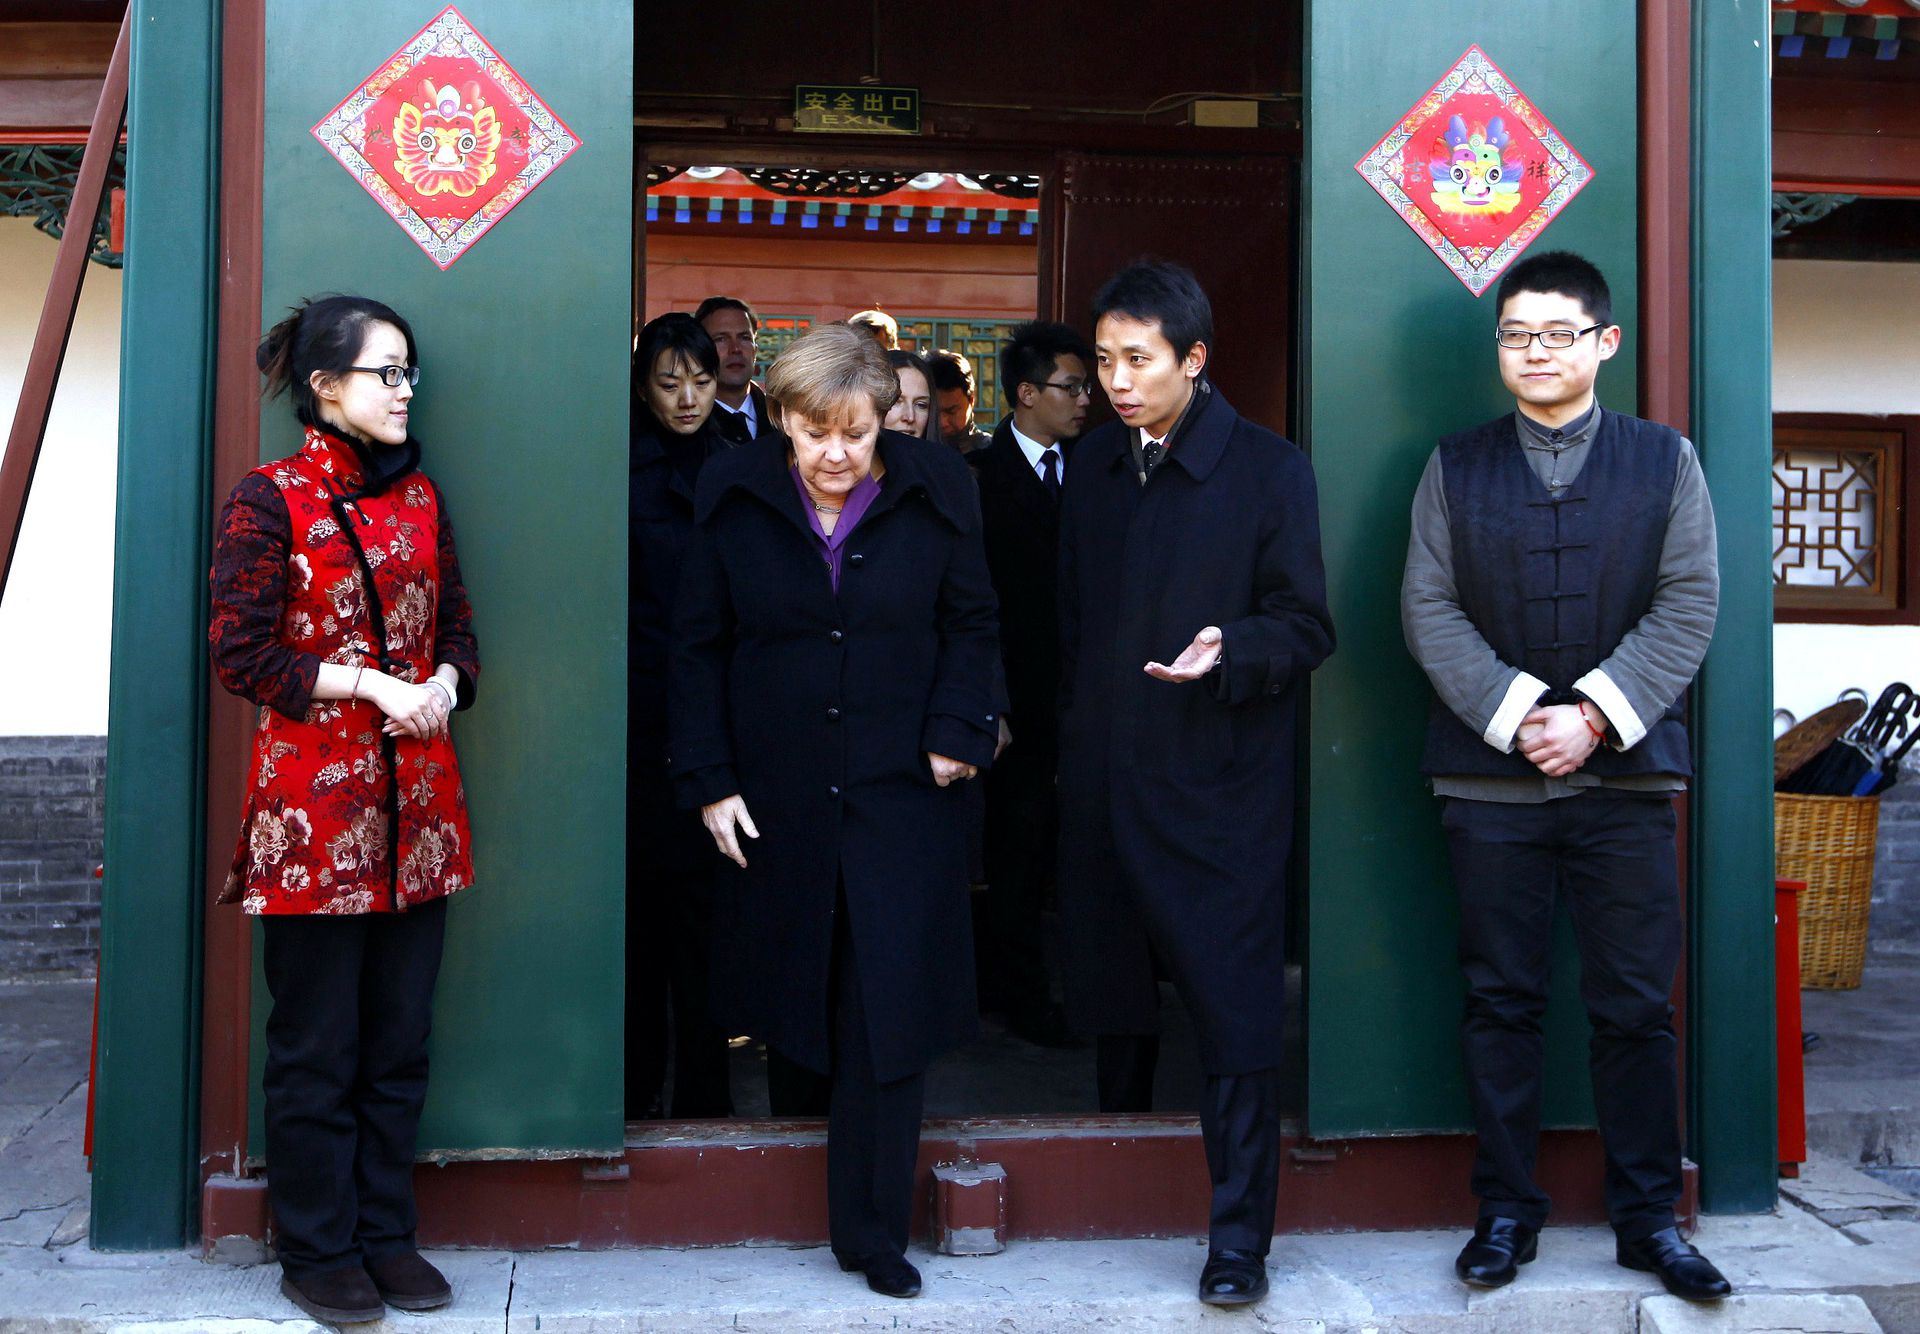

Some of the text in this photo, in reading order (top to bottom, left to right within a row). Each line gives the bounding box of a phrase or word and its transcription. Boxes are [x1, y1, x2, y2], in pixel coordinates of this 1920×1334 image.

[804, 92, 911, 112] 安全出口
[821, 114, 895, 126] EXIT
[1527, 159, 1547, 186] 祥
